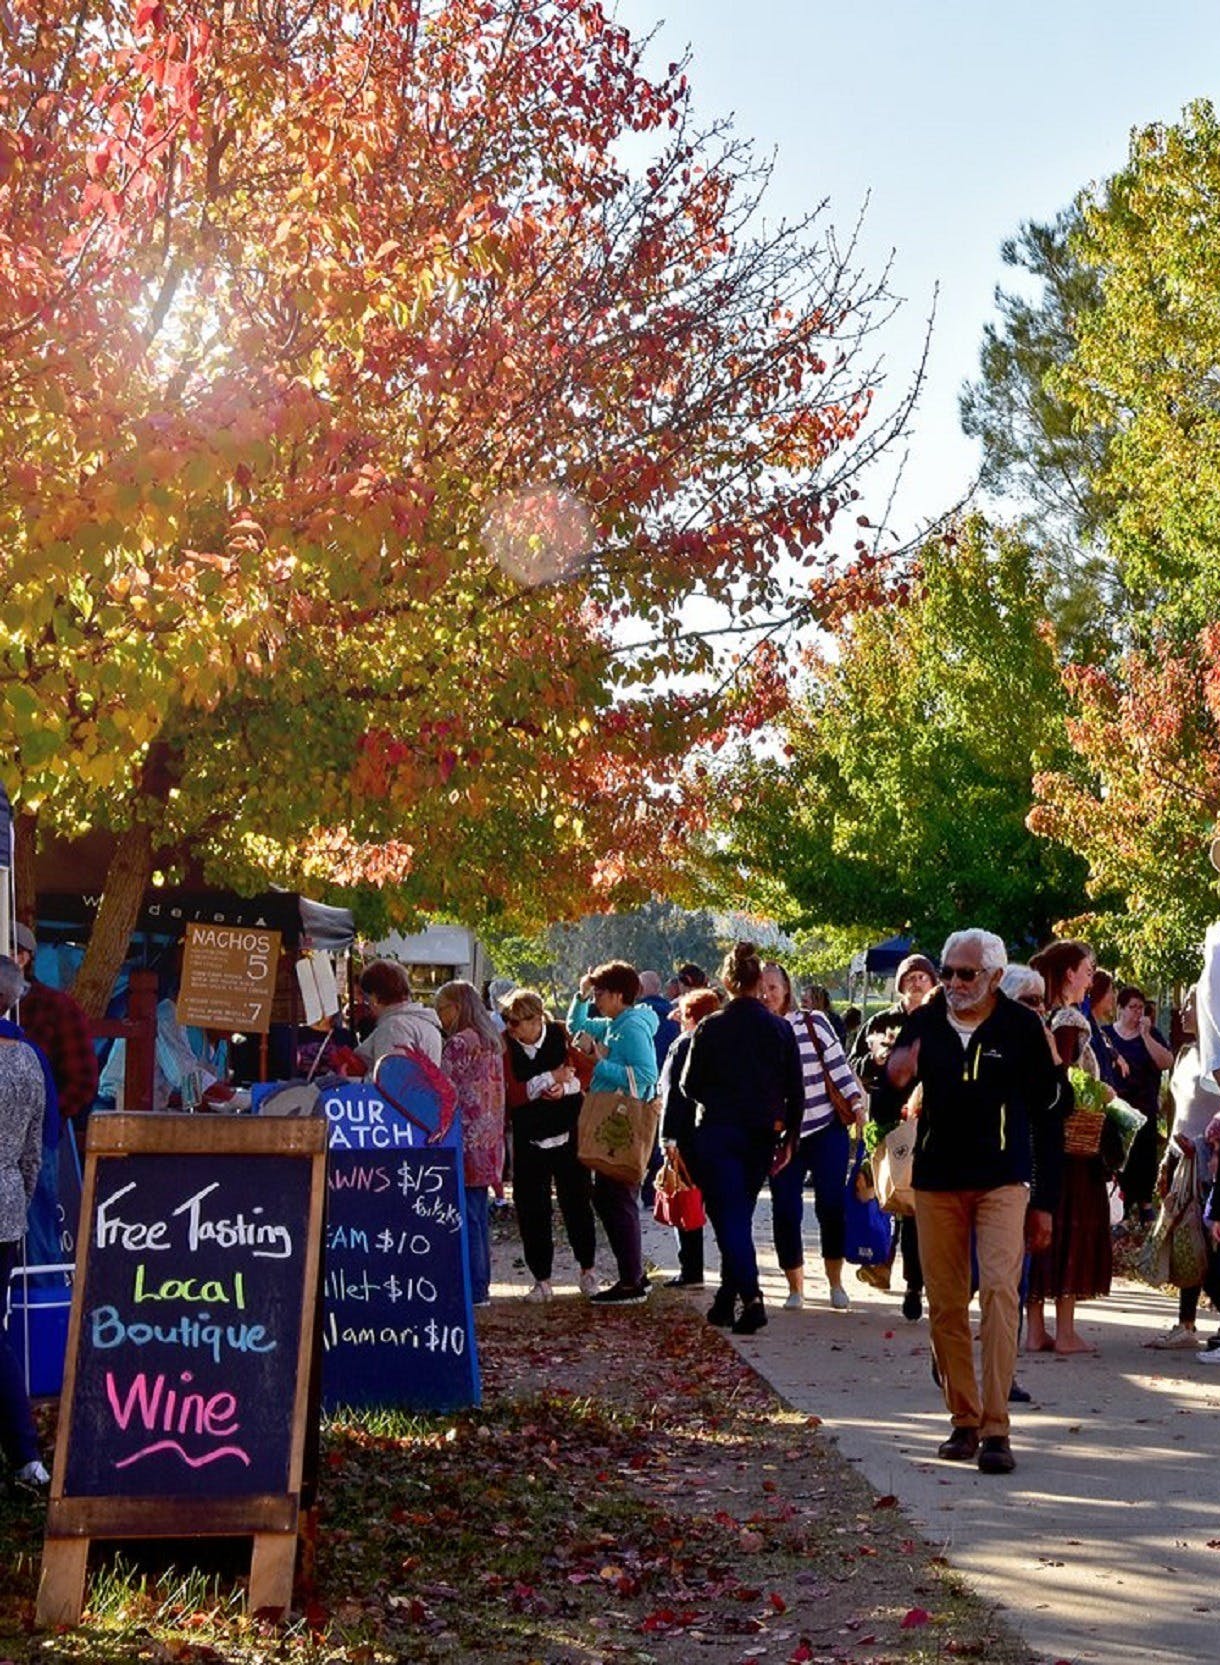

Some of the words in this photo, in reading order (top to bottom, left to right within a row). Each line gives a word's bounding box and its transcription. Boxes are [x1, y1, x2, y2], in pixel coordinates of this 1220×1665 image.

[192, 929, 270, 954] NACHOS
[246, 954, 269, 980] 5
[248, 1002, 262, 1021] 7
[325, 1098, 384, 1124] OUR
[329, 1122, 413, 1148] ATCH
[328, 1166, 391, 1192] WNS
[397, 1160, 450, 1196] $15
[97, 1181, 171, 1250] Free
[172, 1182, 292, 1258] Tasting
[376, 1228, 430, 1254] $10
[134, 1264, 245, 1309] Local
[383, 1274, 438, 1303] $10
[91, 1305, 277, 1363] Boutique
[323, 1312, 418, 1352] lamari
[424, 1318, 464, 1355] $10
[106, 1371, 239, 1436] Wine
